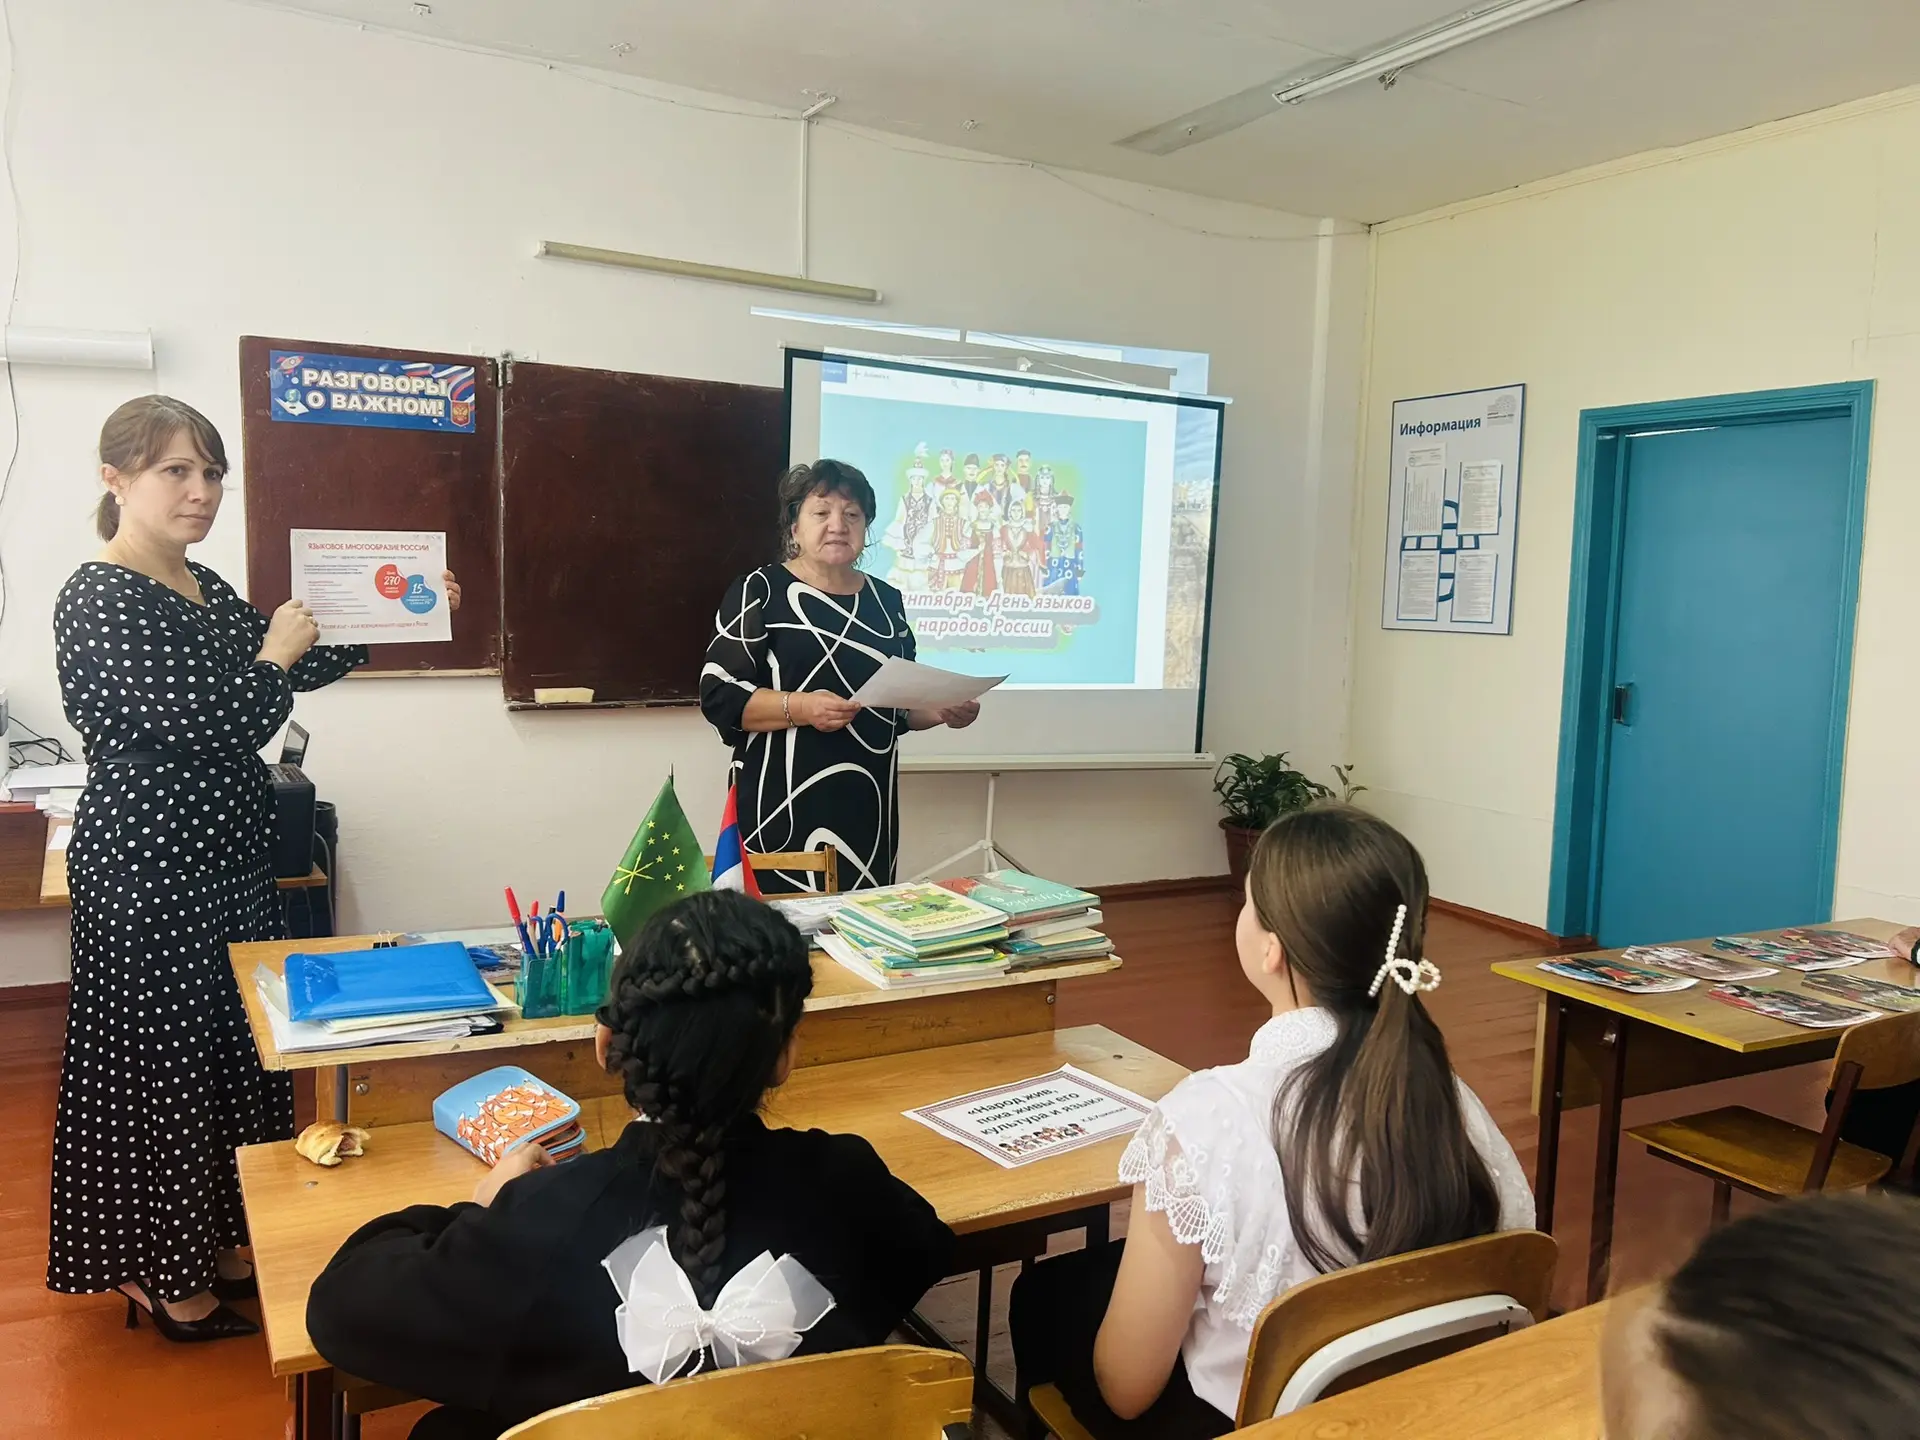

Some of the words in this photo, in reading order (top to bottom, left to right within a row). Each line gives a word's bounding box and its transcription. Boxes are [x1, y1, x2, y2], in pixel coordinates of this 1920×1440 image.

[302, 368, 448, 397] РАЗГОВОРЫ
[306, 390, 325, 408] О
[331, 393, 445, 416] ВАЖНОМ!
[1400, 417, 1481, 436] Информация
[308, 542, 344, 550] ЯЗЫКОВОЕ
[345, 543, 400, 551] МНОГООБРАЗИЕ
[384, 575, 401, 586] 270
[412, 583, 424, 594] 15
[988, 594, 1030, 610] День
[1034, 597, 1092, 609] языков
[917, 615, 988, 635] народов
[993, 619, 1050, 634] России
[968, 1096, 1024, 1115] «Народ
[1025, 1088, 1058, 1101] жив,
[976, 1111, 1011, 1125] пока
[1012, 1099, 1055, 1115] живы
[1056, 1092, 1080, 1104] его
[980, 1113, 1048, 1136] культура
[1050, 1107, 1060, 1117] и
[1061, 1096, 1104, 1112] язык»
